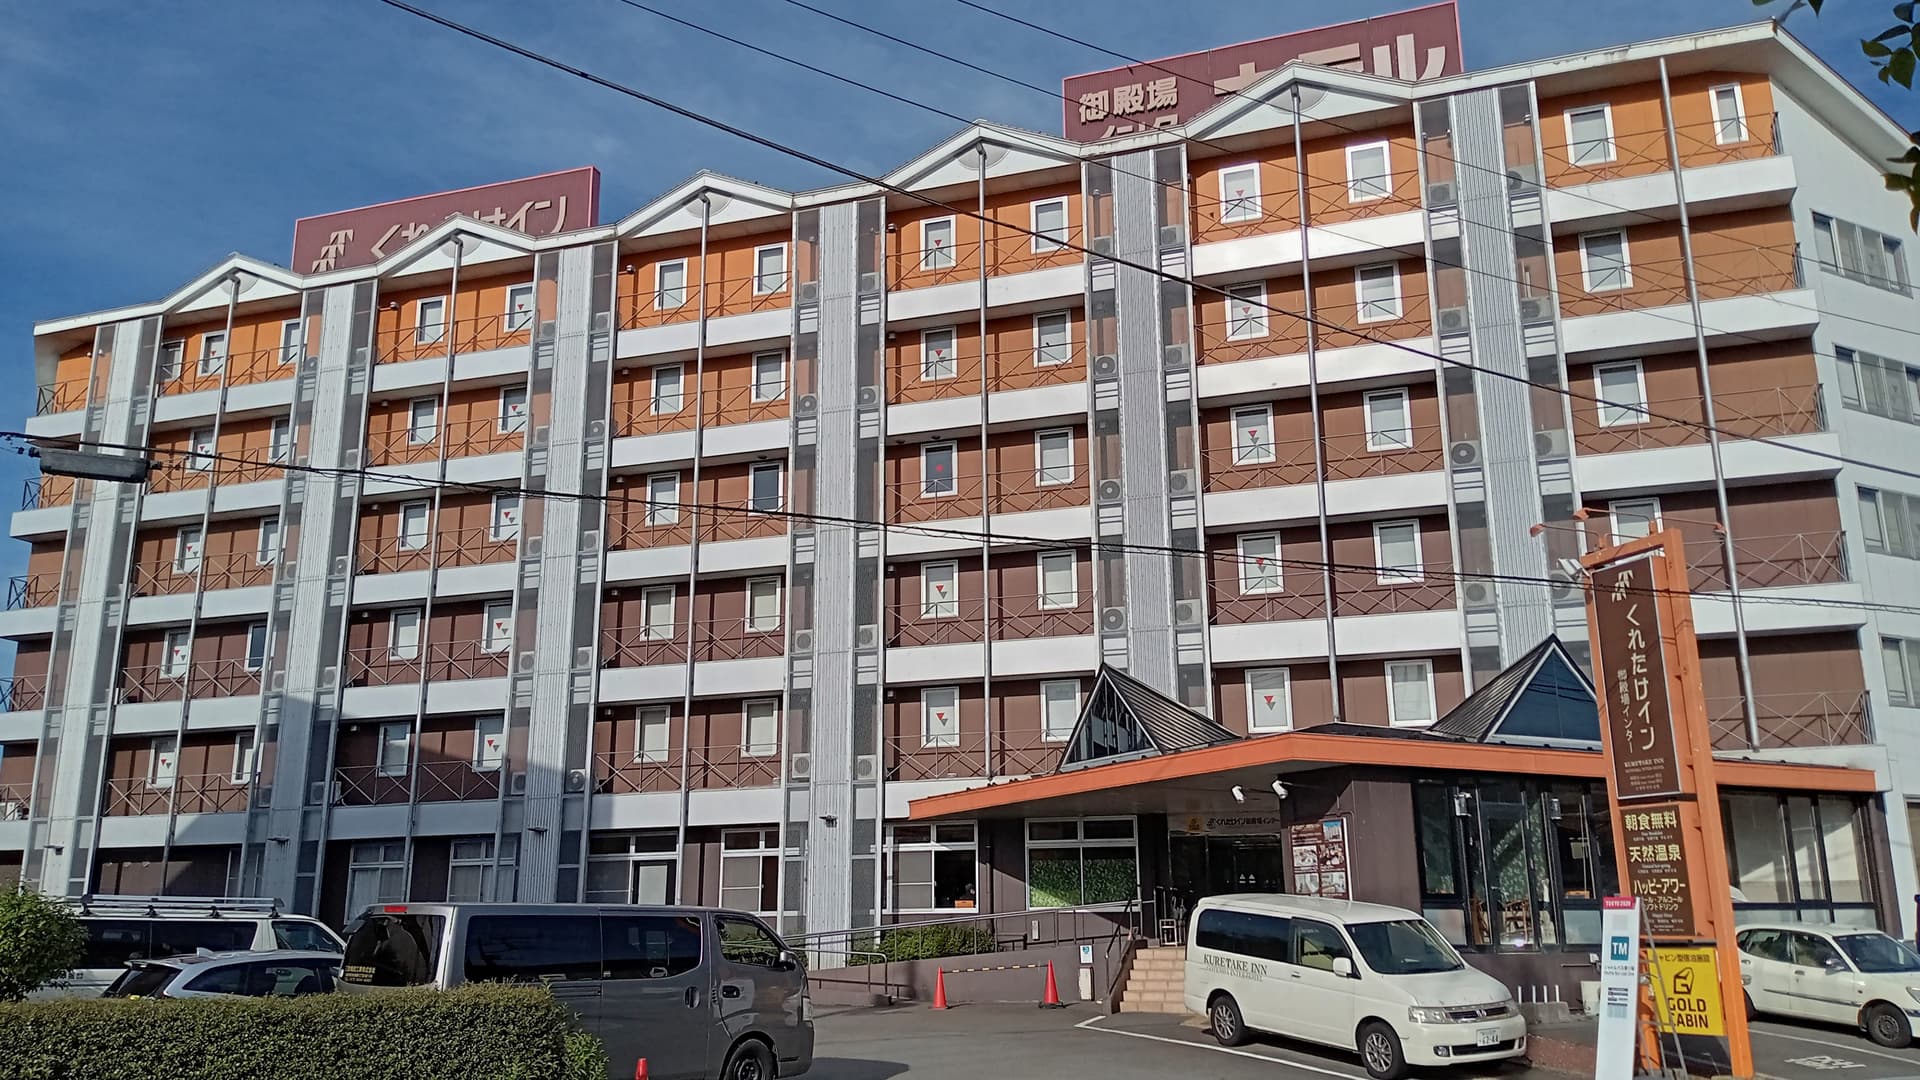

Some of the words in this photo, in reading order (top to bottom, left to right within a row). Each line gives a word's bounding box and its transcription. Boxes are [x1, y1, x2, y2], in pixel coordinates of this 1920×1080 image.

[1079, 76, 1178, 124] 御殿場
[1626, 603, 1655, 751] くれたけイン
[1624, 810, 1677, 831] 朝食無料
[1629, 844, 1682, 863] 天然温泉
[1633, 878, 1686, 895] ハッピーアワー
[1643, 896, 1683, 904] ール・アルコール
[1612, 942, 1628, 955] TM
[1203, 953, 1249, 972] KURETAKE
[1251, 962, 1269, 976] INN
[1667, 997, 1707, 1013] GOLD
[1671, 1012, 1709, 1029] ABIN
